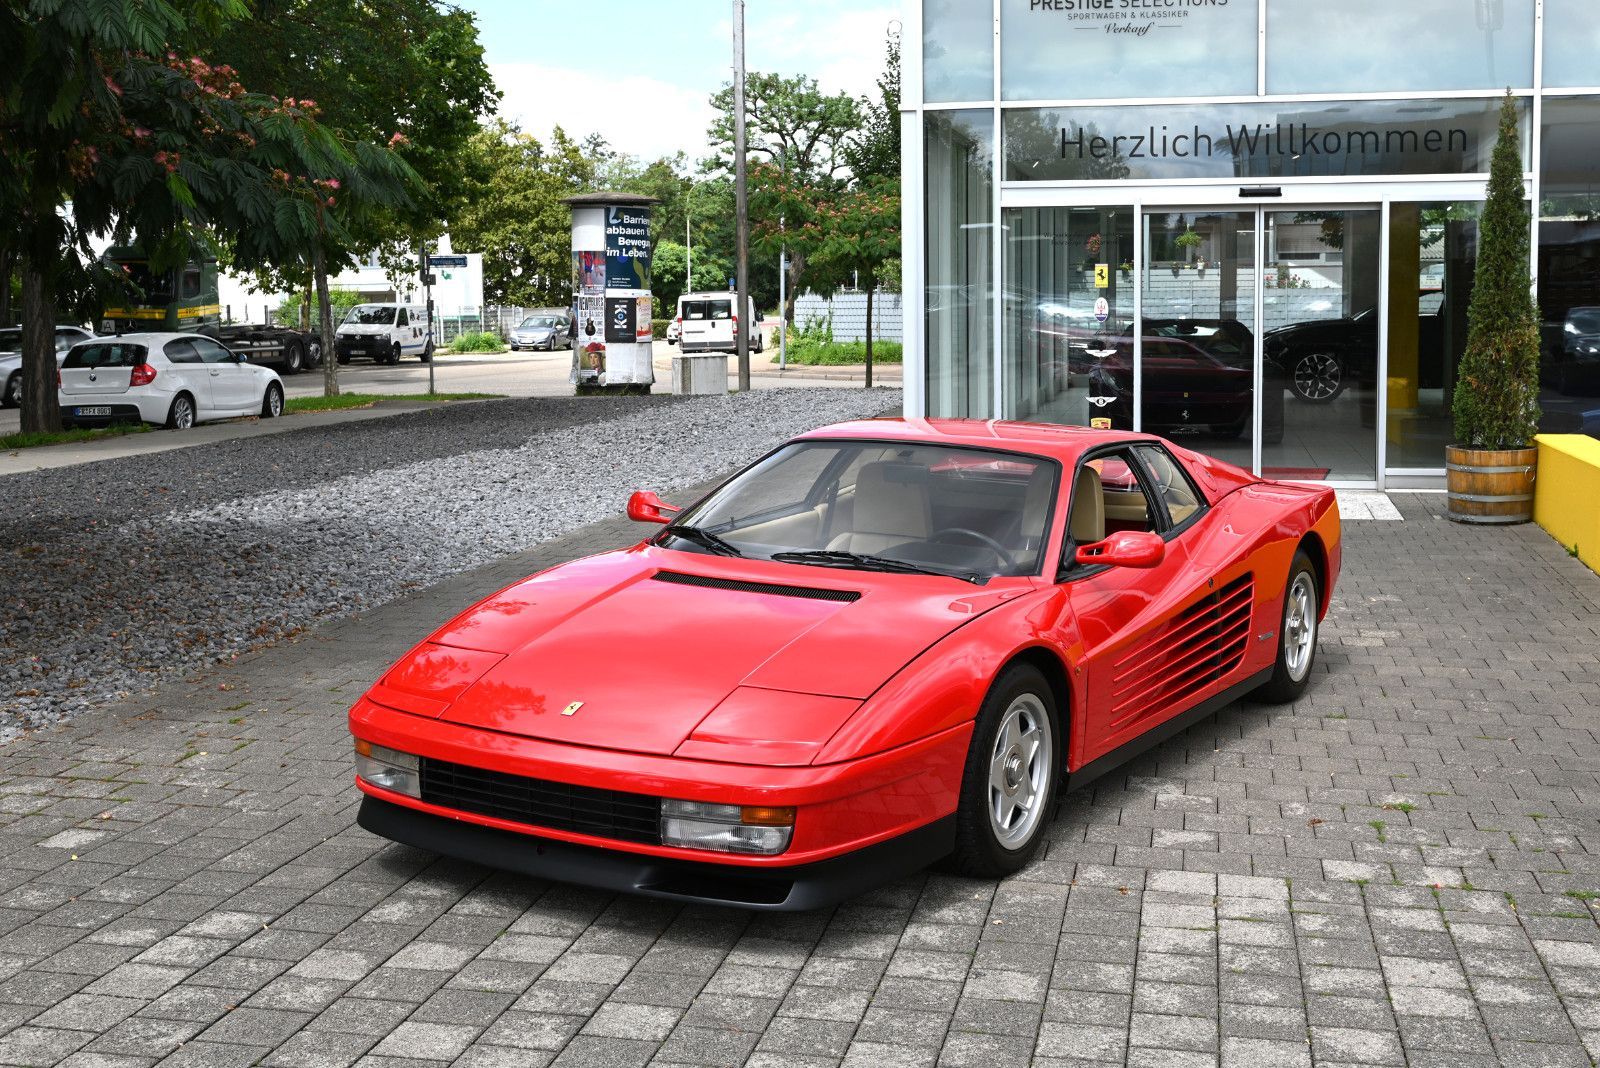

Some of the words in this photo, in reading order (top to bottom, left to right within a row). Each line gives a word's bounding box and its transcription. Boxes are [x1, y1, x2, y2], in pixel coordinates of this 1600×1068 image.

[1030, 0, 1114, 10] PRESTIGE
[1067, 12, 1127, 20] SPORTWAGEN
[1140, 10, 1189, 18] KLASSIKER
[1104, 22, 1155, 36] Verkauf
[1061, 125, 1213, 159] Herzlich
[1226, 122, 1468, 156] Willkommen
[606, 226, 645, 235] abbauen
[606, 247, 619, 256] im
